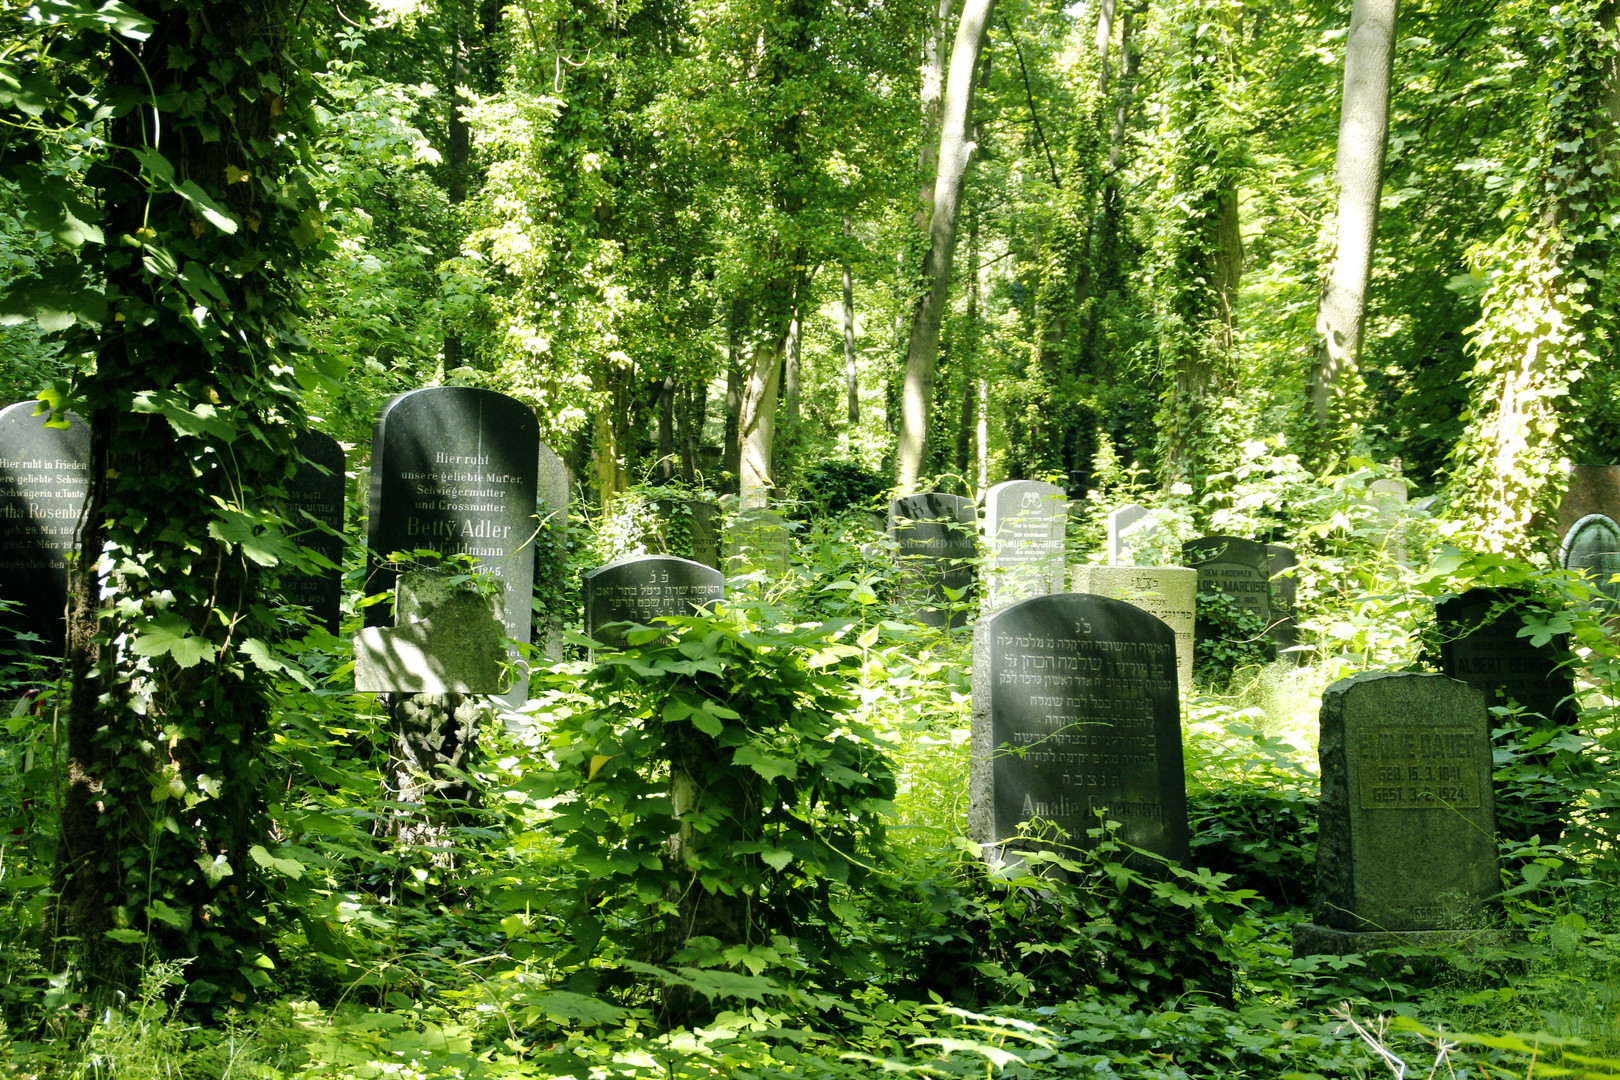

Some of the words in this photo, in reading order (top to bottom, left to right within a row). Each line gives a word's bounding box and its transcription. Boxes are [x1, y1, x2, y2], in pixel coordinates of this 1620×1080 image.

[0, 458, 20, 469] Hier
[22, 459, 42, 469] ruht
[44, 459, 53, 469] in
[55, 459, 87, 470] Frieden
[436, 451, 461, 464] Hier
[465, 453, 490, 466] ruht
[17, 474, 53, 486] geliebte
[401, 472, 438, 481] unsere
[441, 471, 485, 484] geliebte
[0, 488, 52, 500] Schwägerin
[416, 484, 506, 499] Schwiegermutter
[415, 501, 435, 510] und
[438, 499, 506, 512] Grossmutter
[40, 526, 57, 535] Mai
[460, 518, 512, 539] Adler
[37, 539, 61, 550] März
[439, 541, 504, 557] Goldmann
[997, 539, 1028, 549] SAMUE
[1222, 581, 1267, 592] MARCUSE
[1058, 651, 1102, 671] שלמה
[1458, 656, 1501, 674] ALBERT
[1372, 787, 1405, 802] GEST.
[1021, 793, 1080, 817] Amalie
